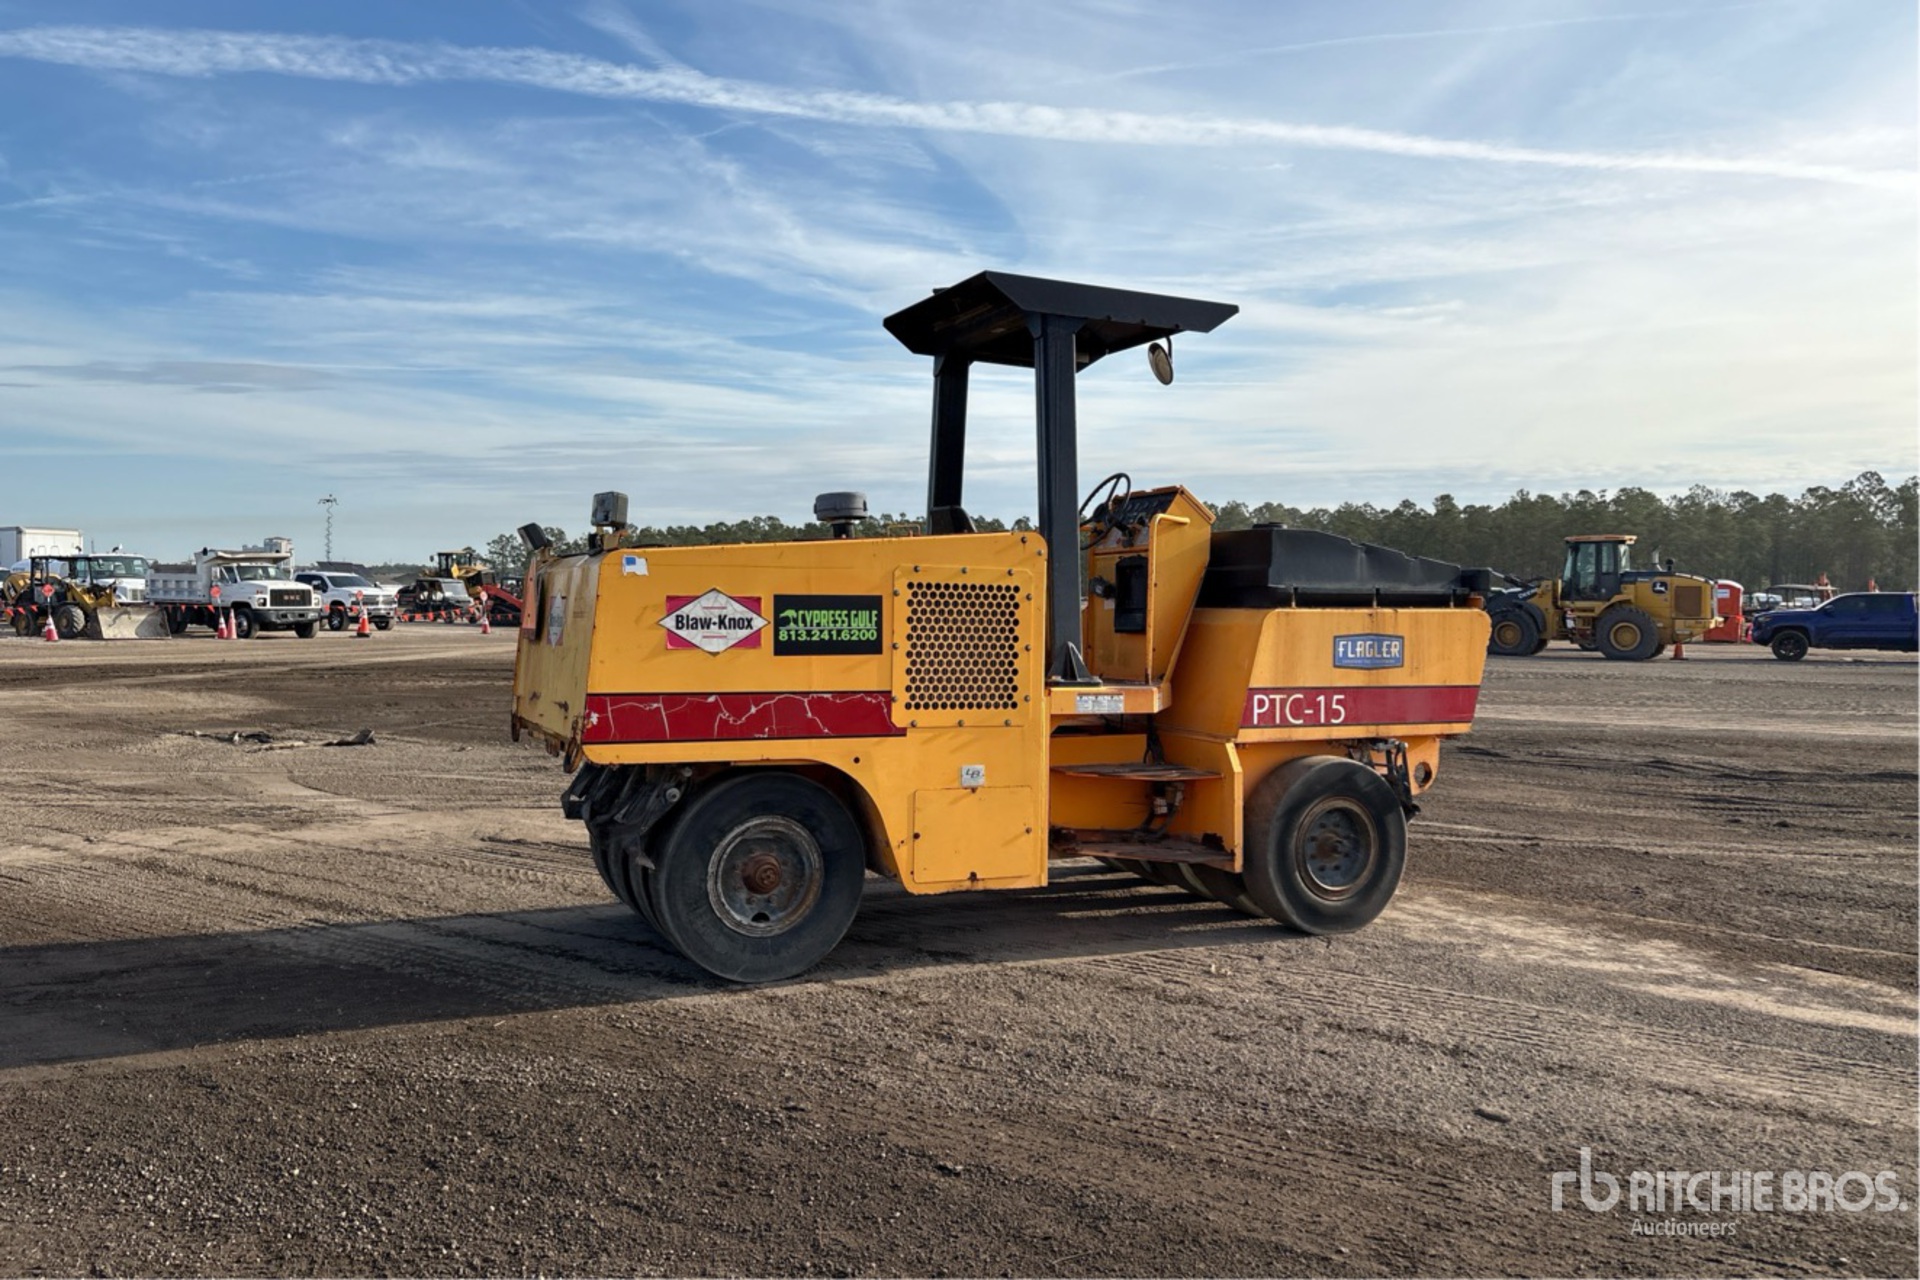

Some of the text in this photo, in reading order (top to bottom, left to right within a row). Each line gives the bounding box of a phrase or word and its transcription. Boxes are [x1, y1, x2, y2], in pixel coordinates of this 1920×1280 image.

[675, 614, 754, 631] Blaw-Knox
[798, 610, 878, 627] CYPRESS GULF
[778, 629, 878, 641] 813.241.6200
[1338, 641, 1400, 658] FLAGLER
[1253, 694, 1346, 725] PTC-15
